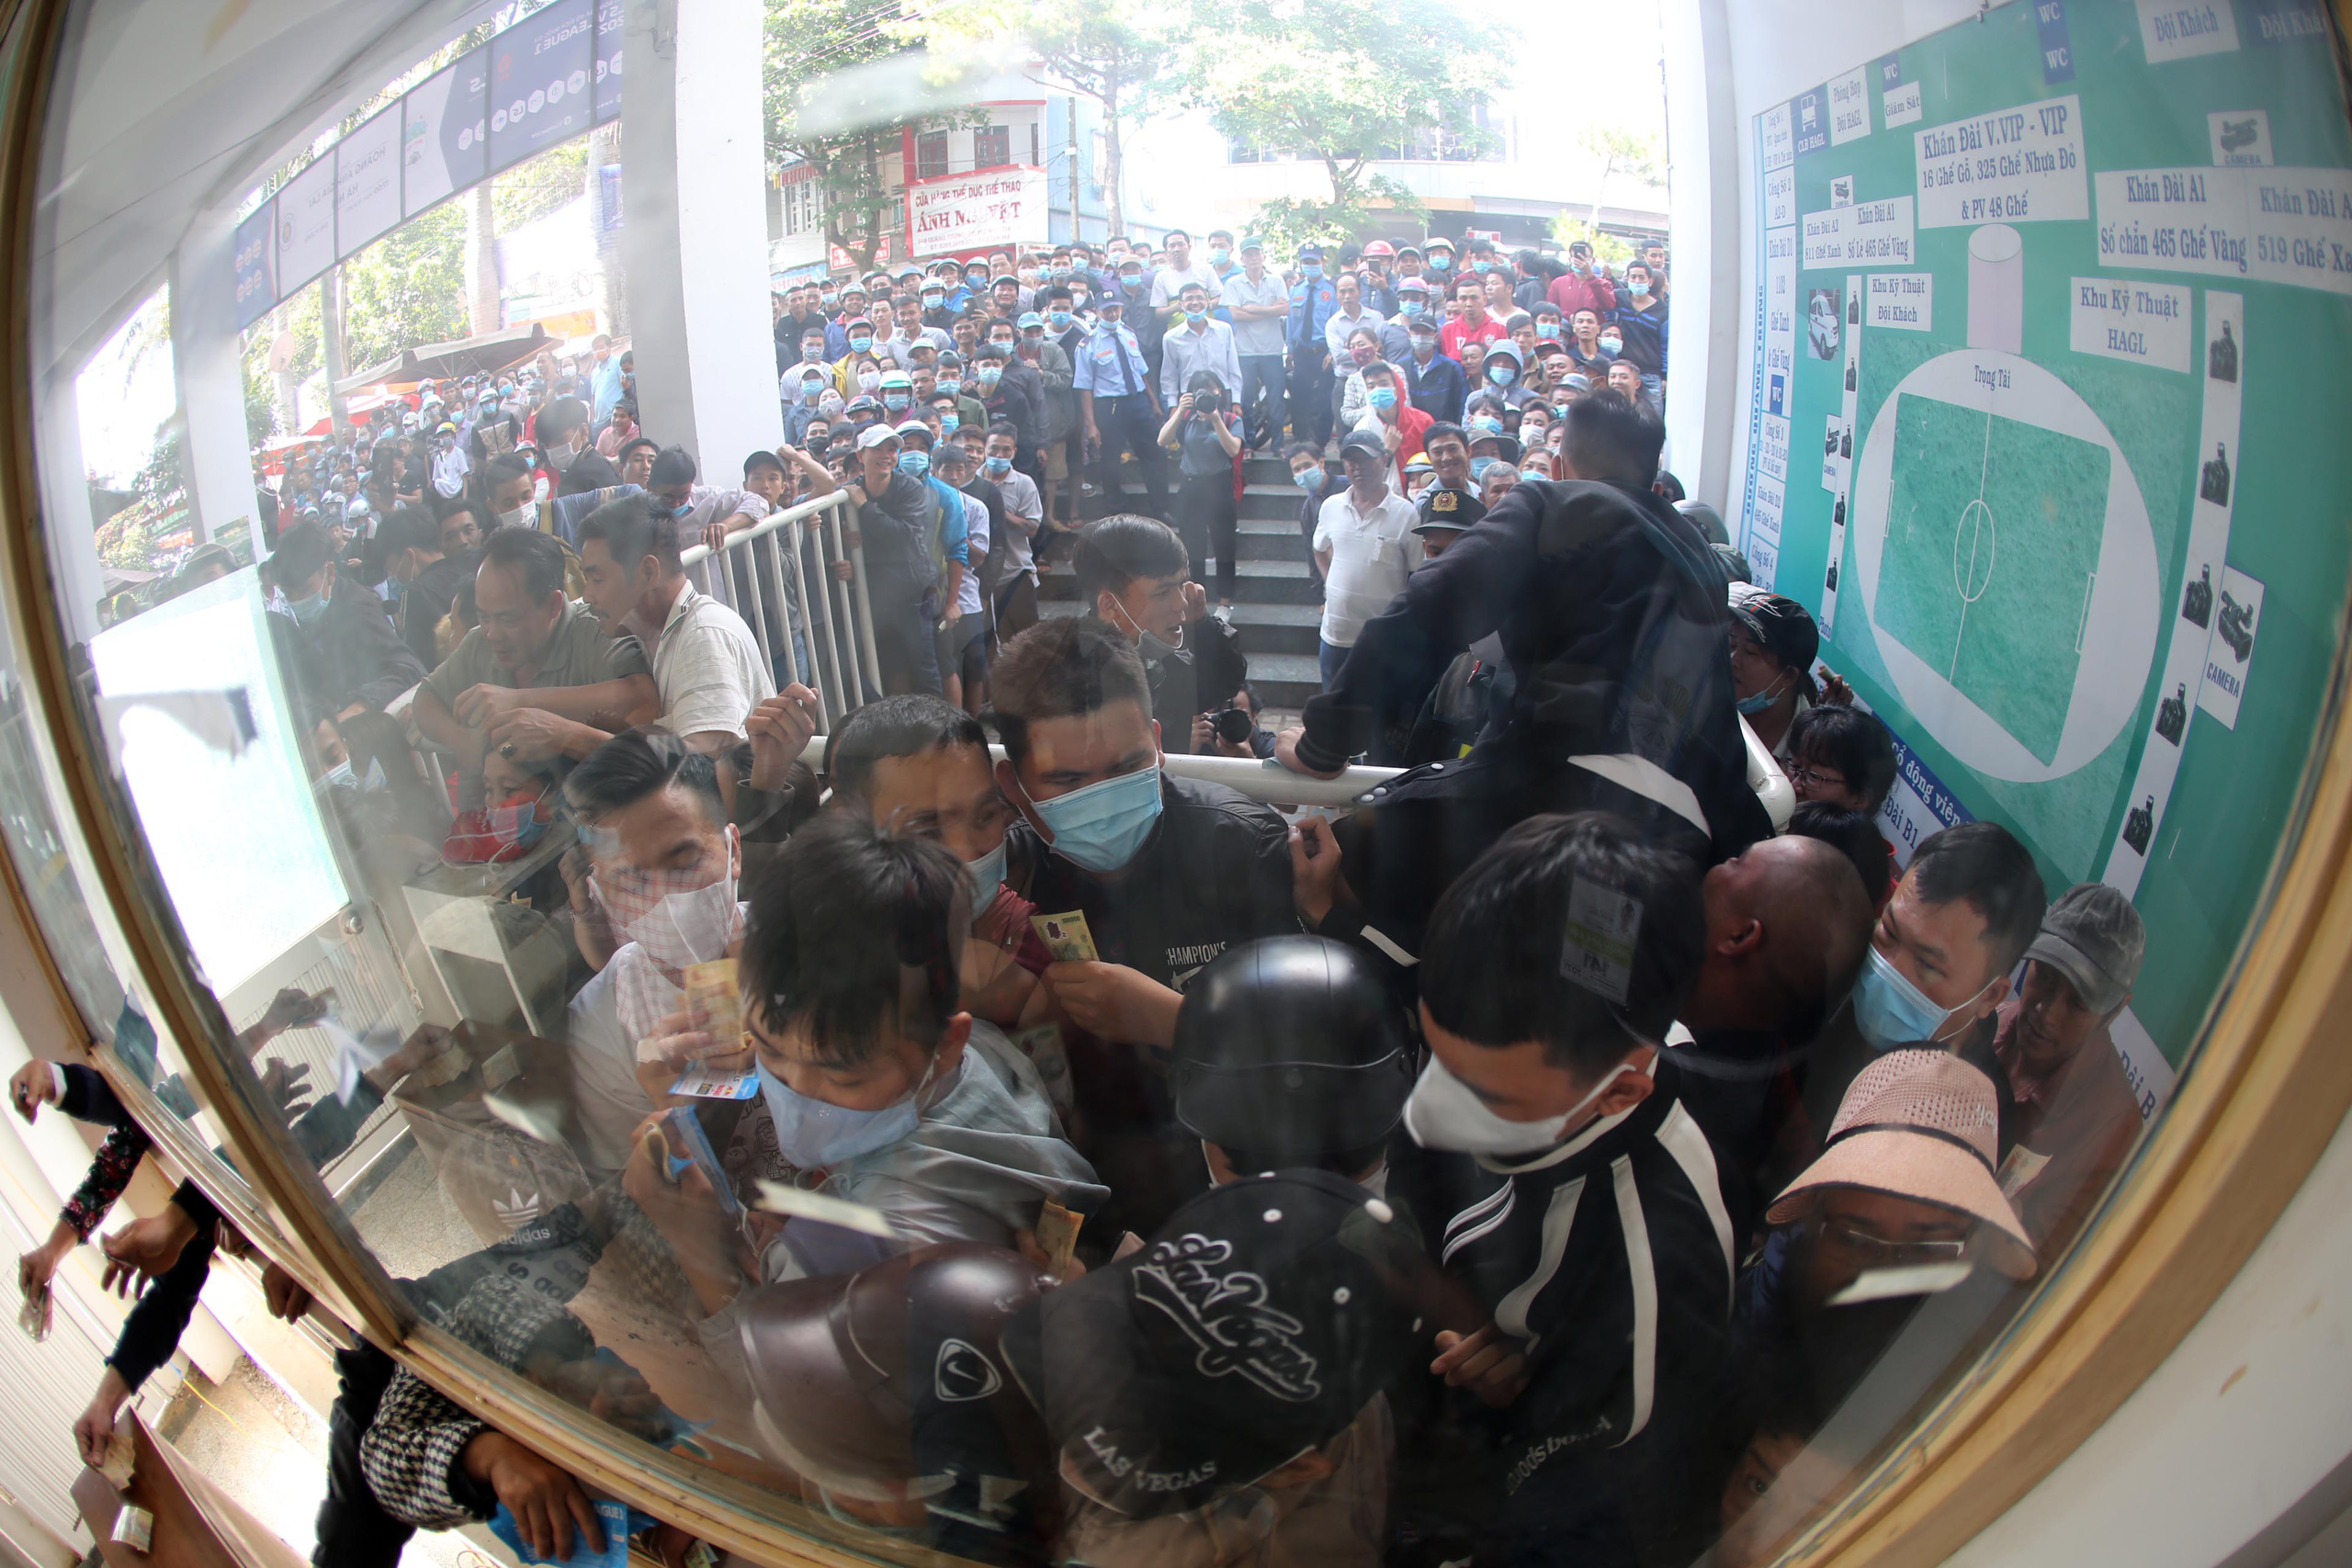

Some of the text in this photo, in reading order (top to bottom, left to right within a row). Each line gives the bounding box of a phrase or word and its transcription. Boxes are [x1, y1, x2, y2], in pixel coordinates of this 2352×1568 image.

[2039, 1, 2060, 23] WC
[2154, 6, 2219, 46] Đội Khách
[2258, 11, 2288, 42] Đội
[1883, 63, 1898, 80] WC
[2046, 48, 2068, 70] WC
[1847, 109, 1861, 130] HAGL
[1885, 96, 1920, 117] Giám Sát
[1798, 132, 1825, 152] CLB HAGL
[1924, 130, 1956, 159] Khán
[1959, 123, 1983, 152] Đài
[1984, 114, 2024, 146] V.VIP
[2039, 105, 2067, 136] VIP
[1923, 142, 2076, 188] 16 Ghế Gỗ, 325 Ghế Nhựa Đỏ
[2224, 154, 2262, 166] CAMERA
[915, 191, 929, 208] CỬA
[968, 184, 983, 200] DỤC
[986, 178, 999, 197] THỂ
[1001, 180, 1021, 194] THAO
[1788, 178, 1792, 191] 2
[2126, 174, 2207, 203] Khán Đài A1
[1858, 203, 1894, 225] Khán Đài A1
[1962, 189, 2029, 220] & PV 48 Ghế
[2260, 186, 2302, 216] Khán
[2306, 188, 2336, 219] Đài
[917, 211, 950, 232] ÁNH
[1807, 219, 1839, 236] Khán Đài A2
[1805, 243, 1841, 260] 811 Ghế Xanh
[1849, 238, 1856, 259] Số
[1865, 240, 1876, 258] 465
[1878, 234, 1891, 257] Ghế
[1892, 237, 1908, 262] Vàng
[2101, 220, 2248, 274] Số chẵn 465 Ghế Vàng
[2257, 235, 2288, 264] 519
[2293, 237, 2326, 269] Ghế
[1872, 278, 1926, 298] Khu Kỹ Thuật
[1878, 306, 1917, 323] Đội Khách
[2081, 287, 2178, 323] Khu Kỹ Thuật
[2108, 328, 2147, 355] HAGL
[1974, 365, 2010, 391] Trọng Tài
[1772, 386, 1782, 402] WC
[2207, 662, 2240, 698] CAMERA
[1905, 761, 1934, 804] động
[1935, 793, 1961, 825] viên
[1884, 795, 1918, 849] Đài B1
[1165, 941, 1226, 965] HAMPION'S
[498, 1227, 551, 1246] adidas
[1083, 1426, 1217, 1492] LAS VEGAS
